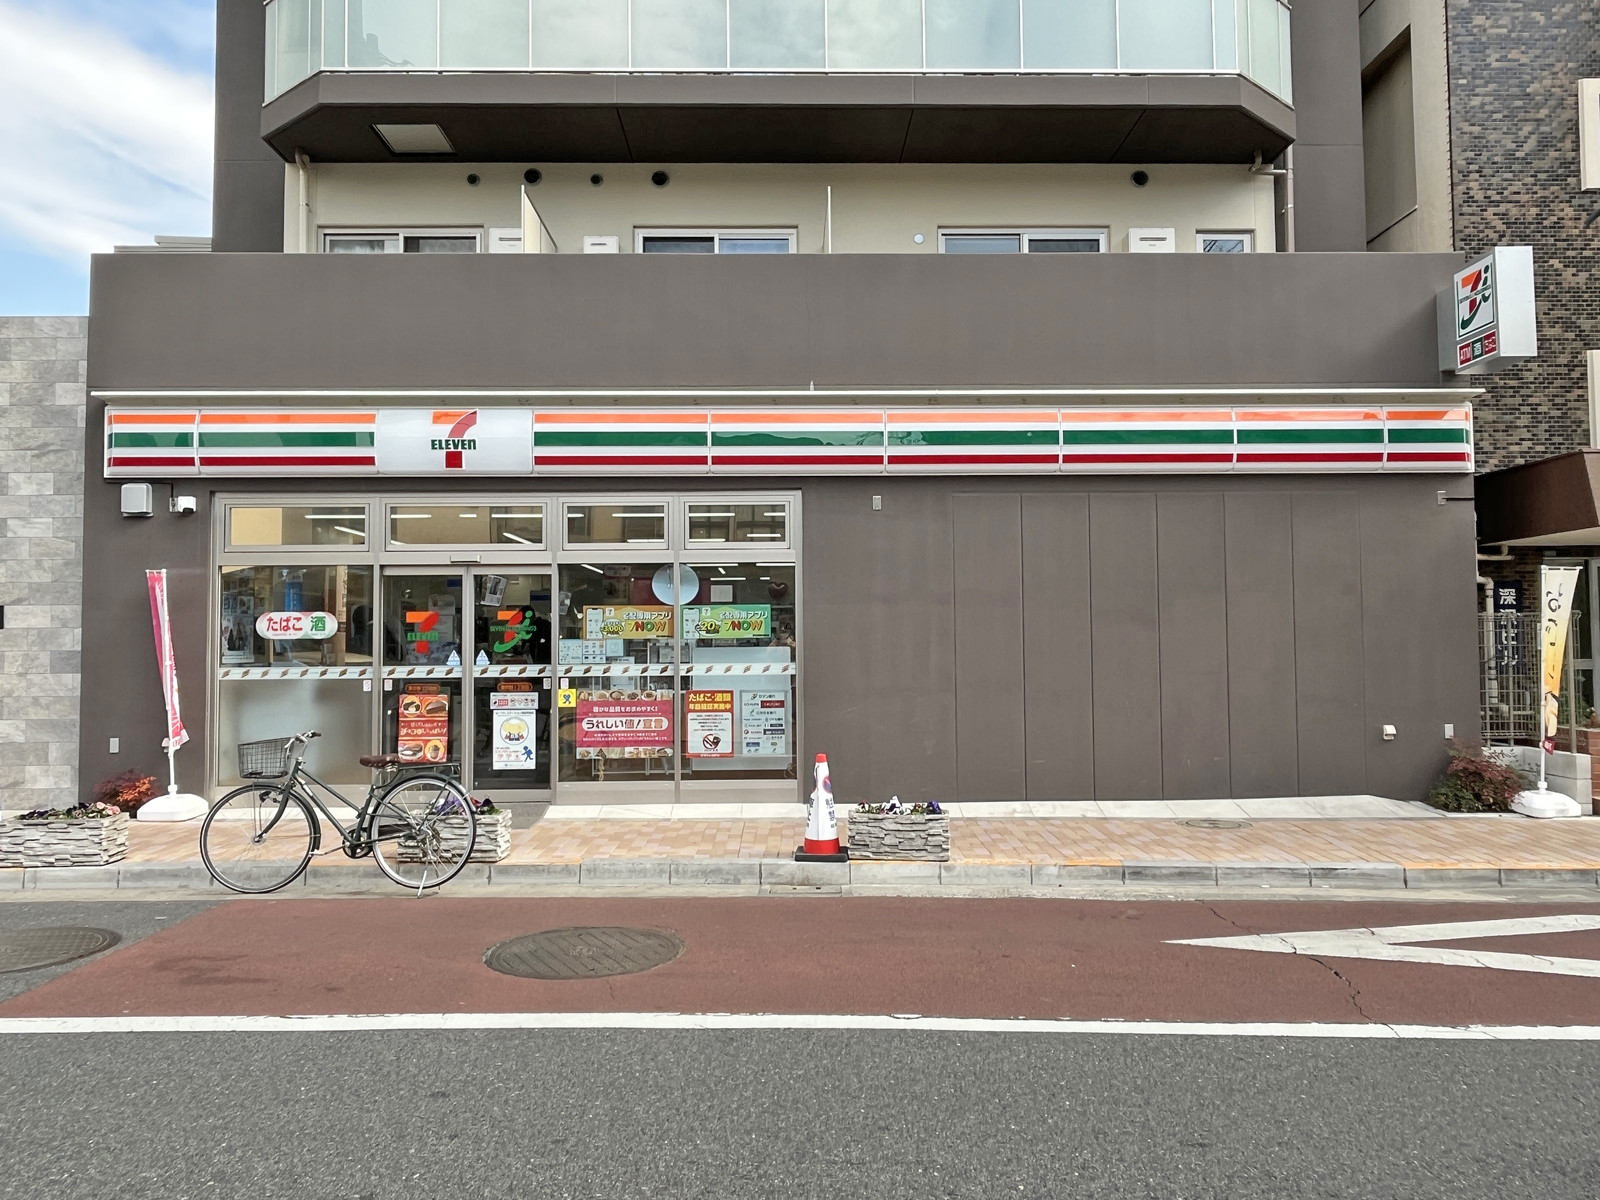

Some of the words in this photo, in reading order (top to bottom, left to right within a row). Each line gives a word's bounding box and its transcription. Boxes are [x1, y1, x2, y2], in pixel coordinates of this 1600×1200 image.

[432, 409, 478, 468] 7
[266, 615, 303, 632] たばこ
[310, 616, 326, 632] 酒
